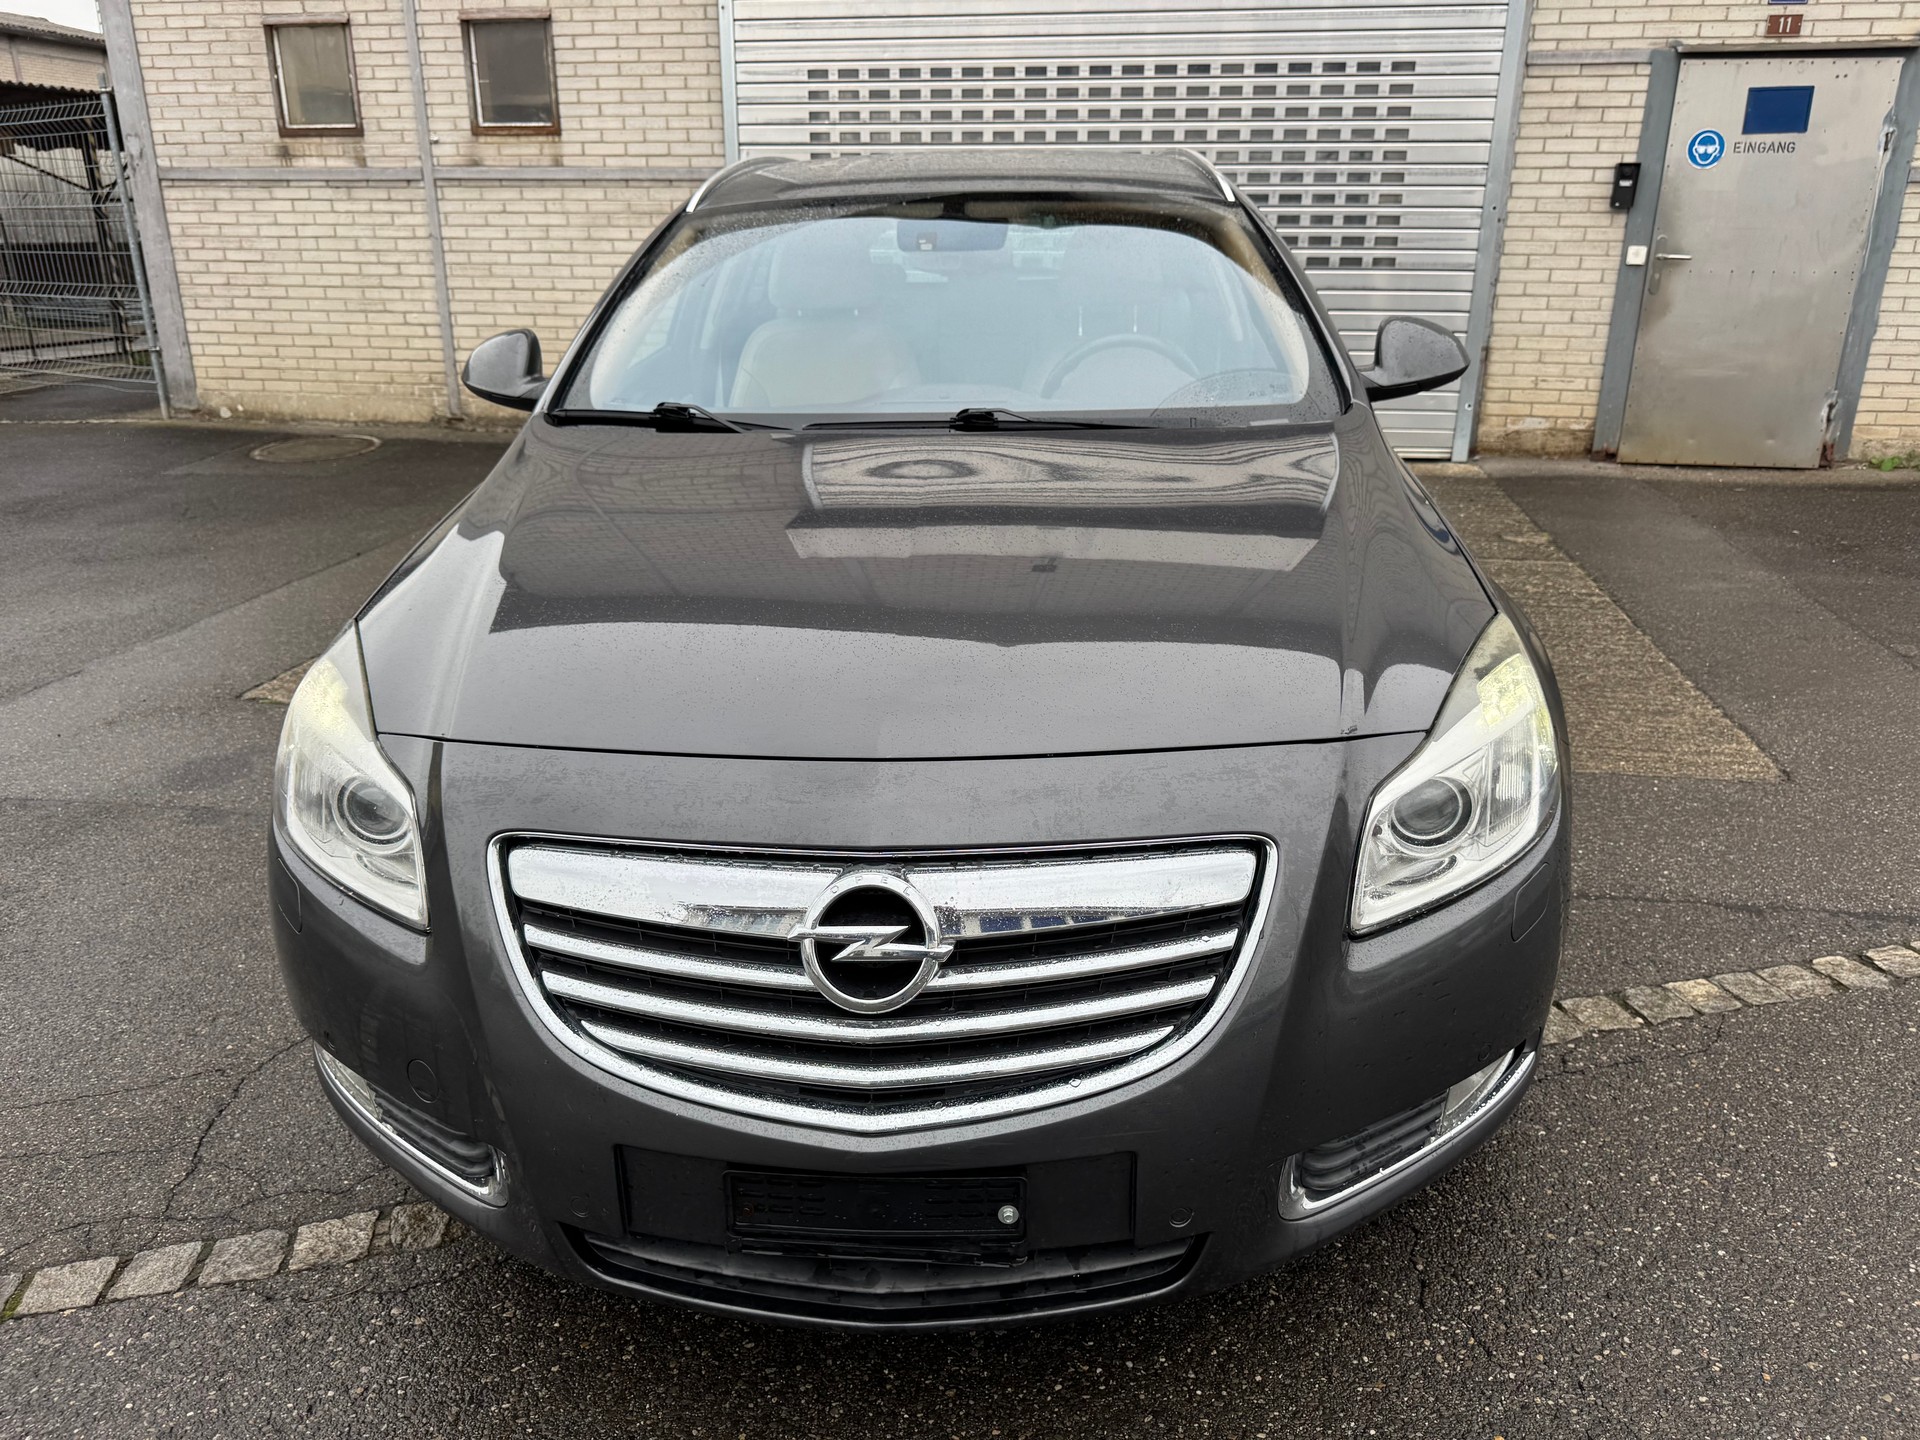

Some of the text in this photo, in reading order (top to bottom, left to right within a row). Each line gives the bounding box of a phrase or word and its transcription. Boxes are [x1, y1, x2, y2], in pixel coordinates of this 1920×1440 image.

[1779, 17, 1792, 33] 11
[1733, 141, 1796, 154] EINGANG
[830, 876, 911, 896] OPEL
